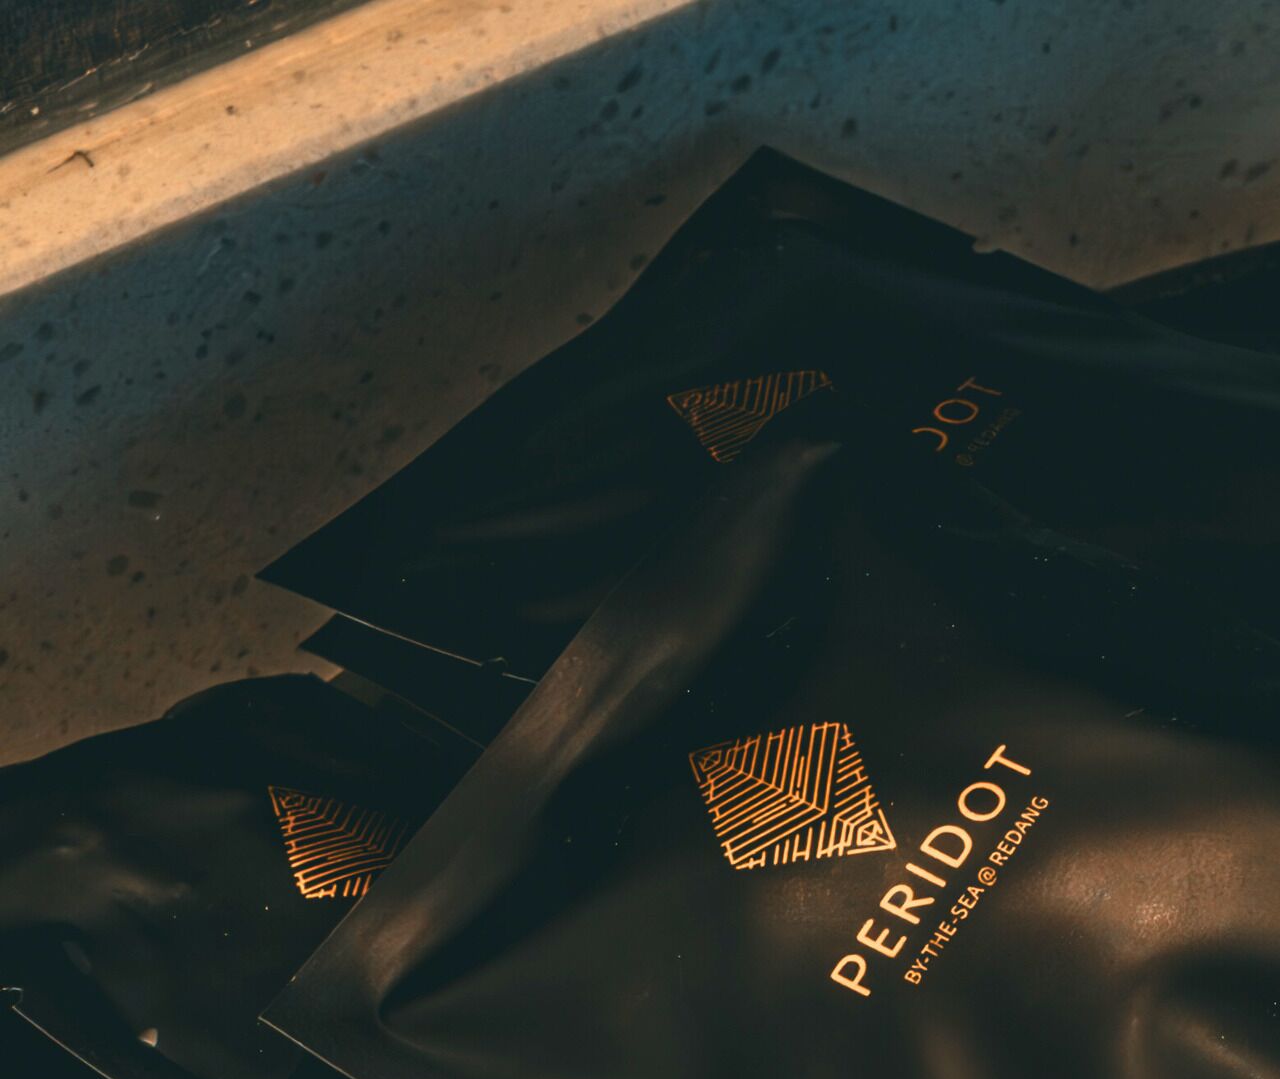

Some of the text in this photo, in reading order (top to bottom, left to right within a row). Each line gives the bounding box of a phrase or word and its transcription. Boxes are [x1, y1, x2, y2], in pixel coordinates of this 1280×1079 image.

[829, 744, 1032, 997] PERIDOT
[904, 796, 1049, 984] BY-THE-SEA @ REDANG
